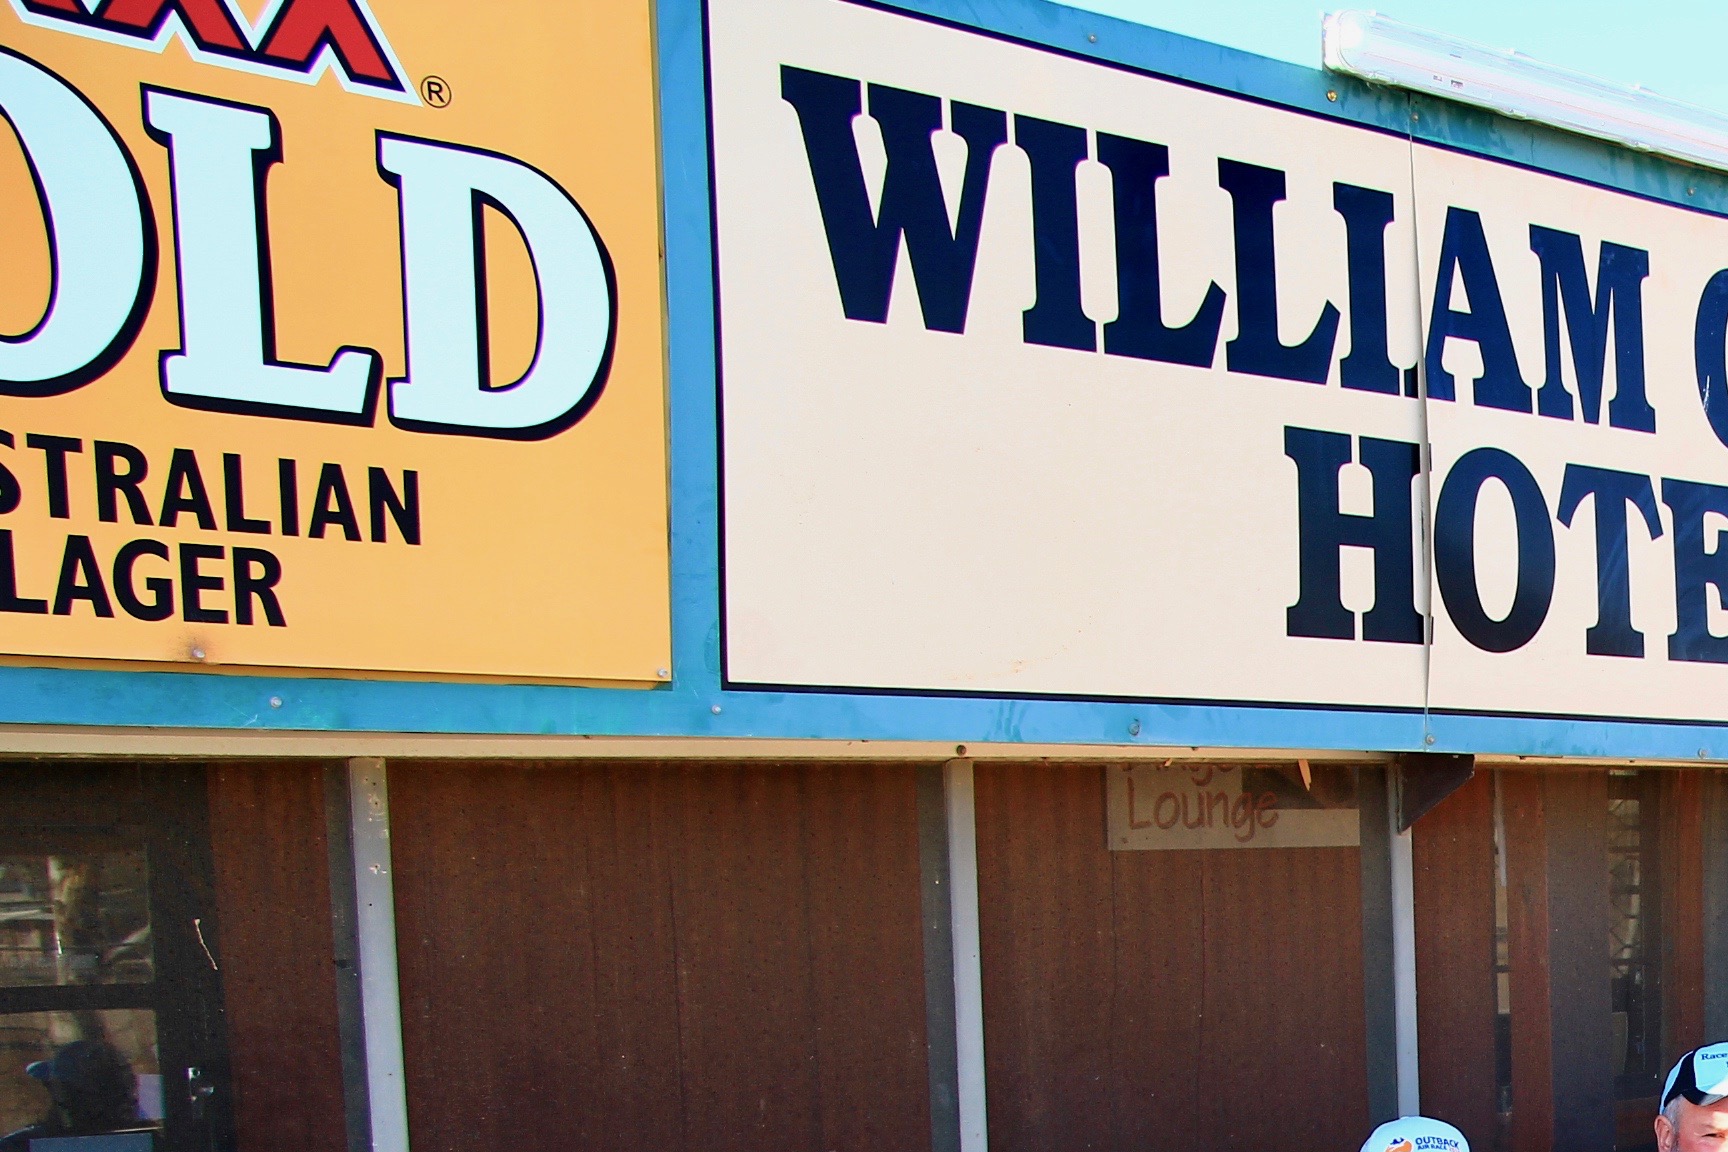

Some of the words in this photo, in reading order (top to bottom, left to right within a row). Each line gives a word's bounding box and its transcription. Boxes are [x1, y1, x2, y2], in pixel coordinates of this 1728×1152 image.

[780, 64, 1657, 434] WILLIAM
[0, 528, 288, 629] LAGER
[1127, 776, 1280, 843] Lounge
[1701, 1052, 1728, 1061] Race
[1415, 1136, 1460, 1149] OUTBACK
[1417, 1143, 1430, 1151] AIR
